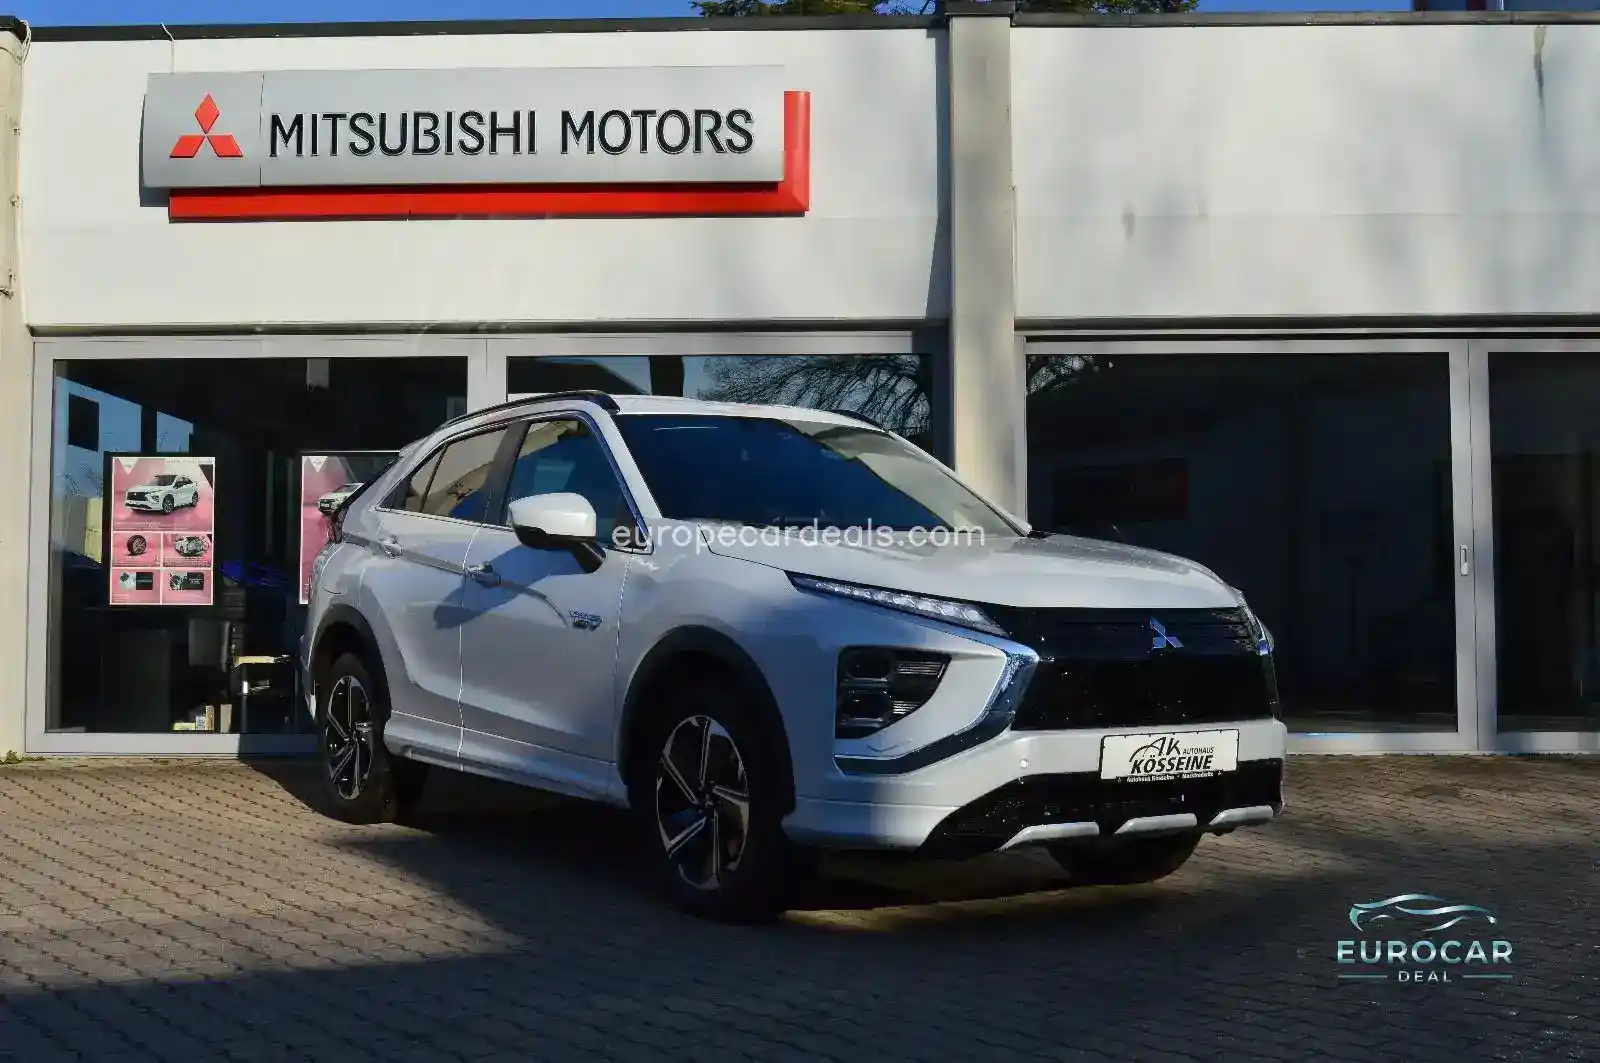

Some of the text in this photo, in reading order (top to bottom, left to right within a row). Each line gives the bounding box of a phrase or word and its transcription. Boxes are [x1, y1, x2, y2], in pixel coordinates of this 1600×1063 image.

[269, 109, 755, 157] MITSUBISHI MOTORS
[1183, 747, 1214, 755] AUTOHAUS
[1131, 755, 1214, 774] KÖSSEINE
